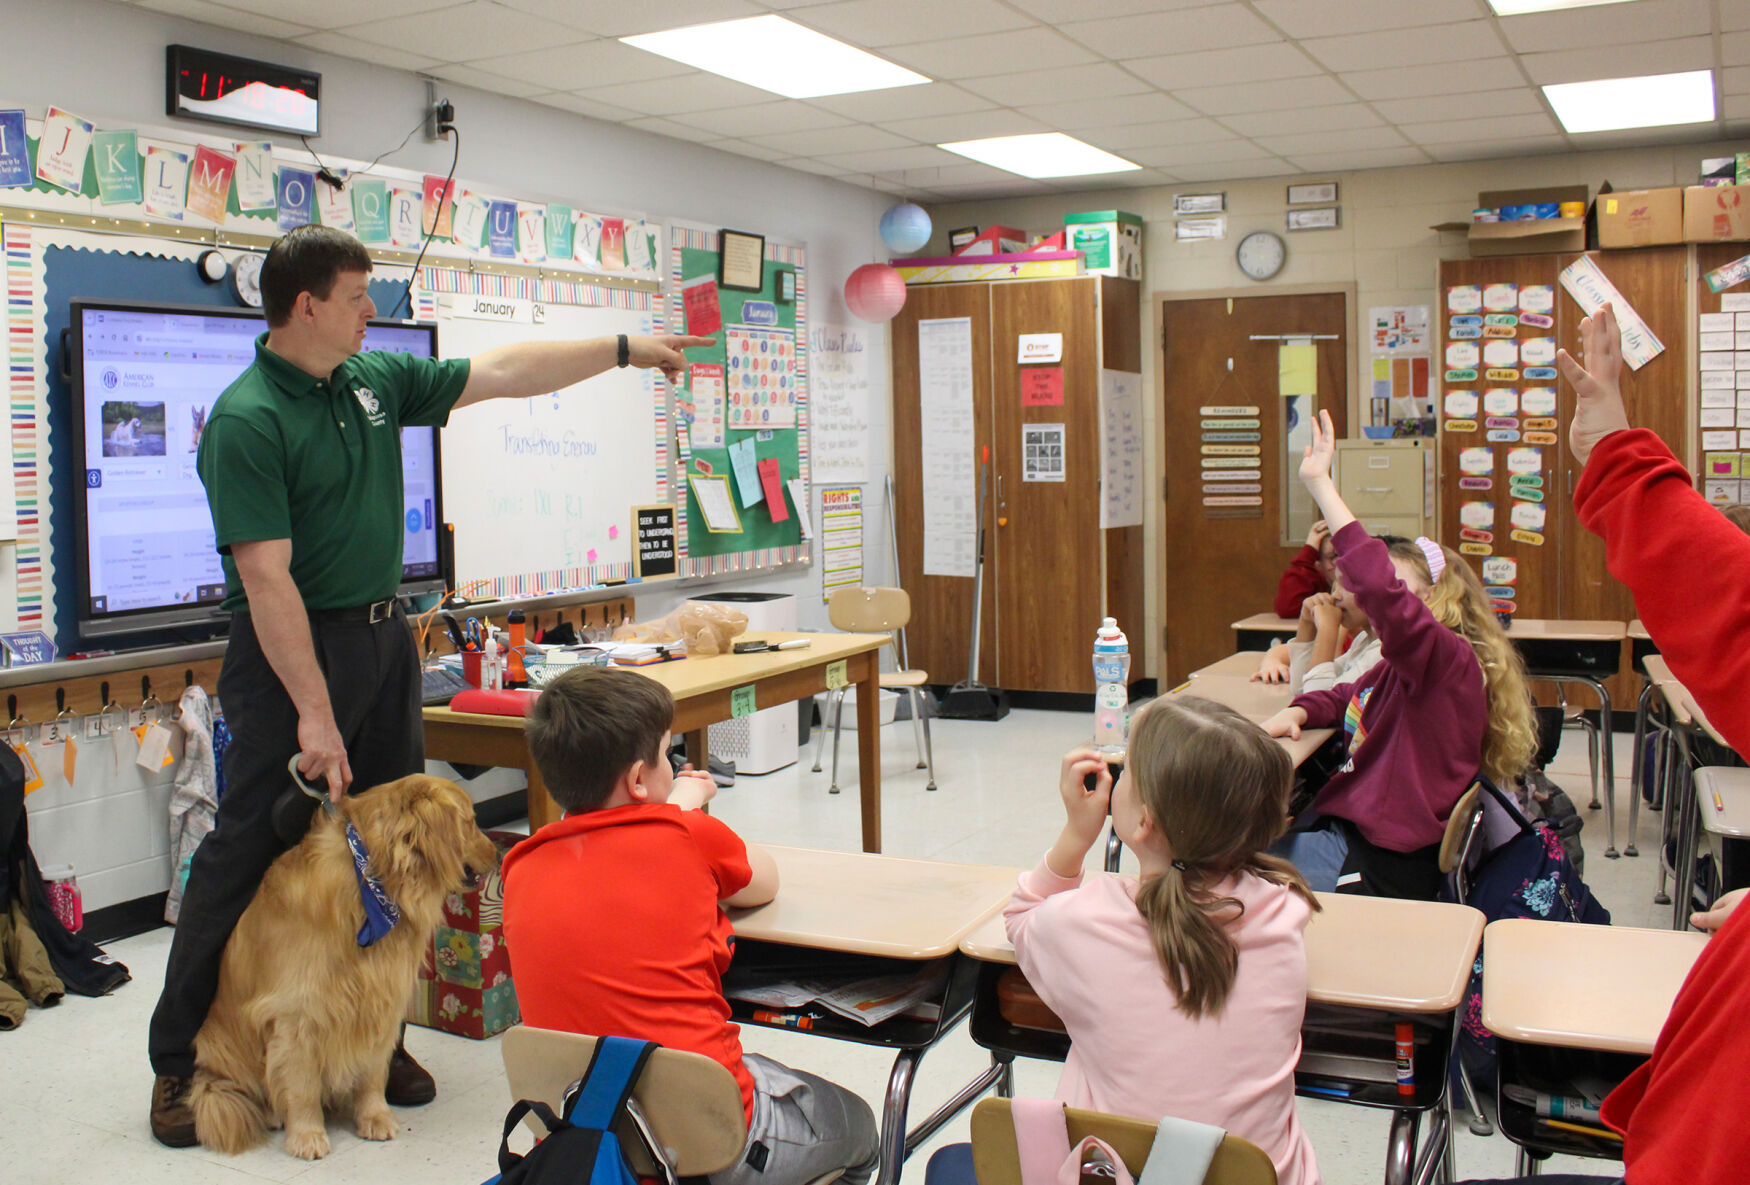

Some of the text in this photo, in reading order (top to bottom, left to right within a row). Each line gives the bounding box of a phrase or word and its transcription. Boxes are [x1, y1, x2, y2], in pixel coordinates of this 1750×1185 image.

[56, 126, 72, 156] J
[105, 143, 127, 173] K
[243, 154, 262, 182] N
[158, 160, 172, 189] L
[200, 159, 225, 193] M
[285, 180, 305, 207] O
[362, 192, 380, 218] Q
[400, 200, 411, 225] R
[466, 201, 481, 226] T
[495, 210, 510, 234] U
[551, 213, 569, 235] W
[525, 219, 538, 241] V
[580, 223, 595, 247] X
[607, 227, 618, 249] Y
[633, 230, 642, 250] Z
[473, 299, 545, 319] January 24
[823, 492, 849, 504] RIGHTS
[13, 636, 42, 646] THOUGHT
[23, 651, 43, 663] DAY
[49, 726, 58, 741] 3
